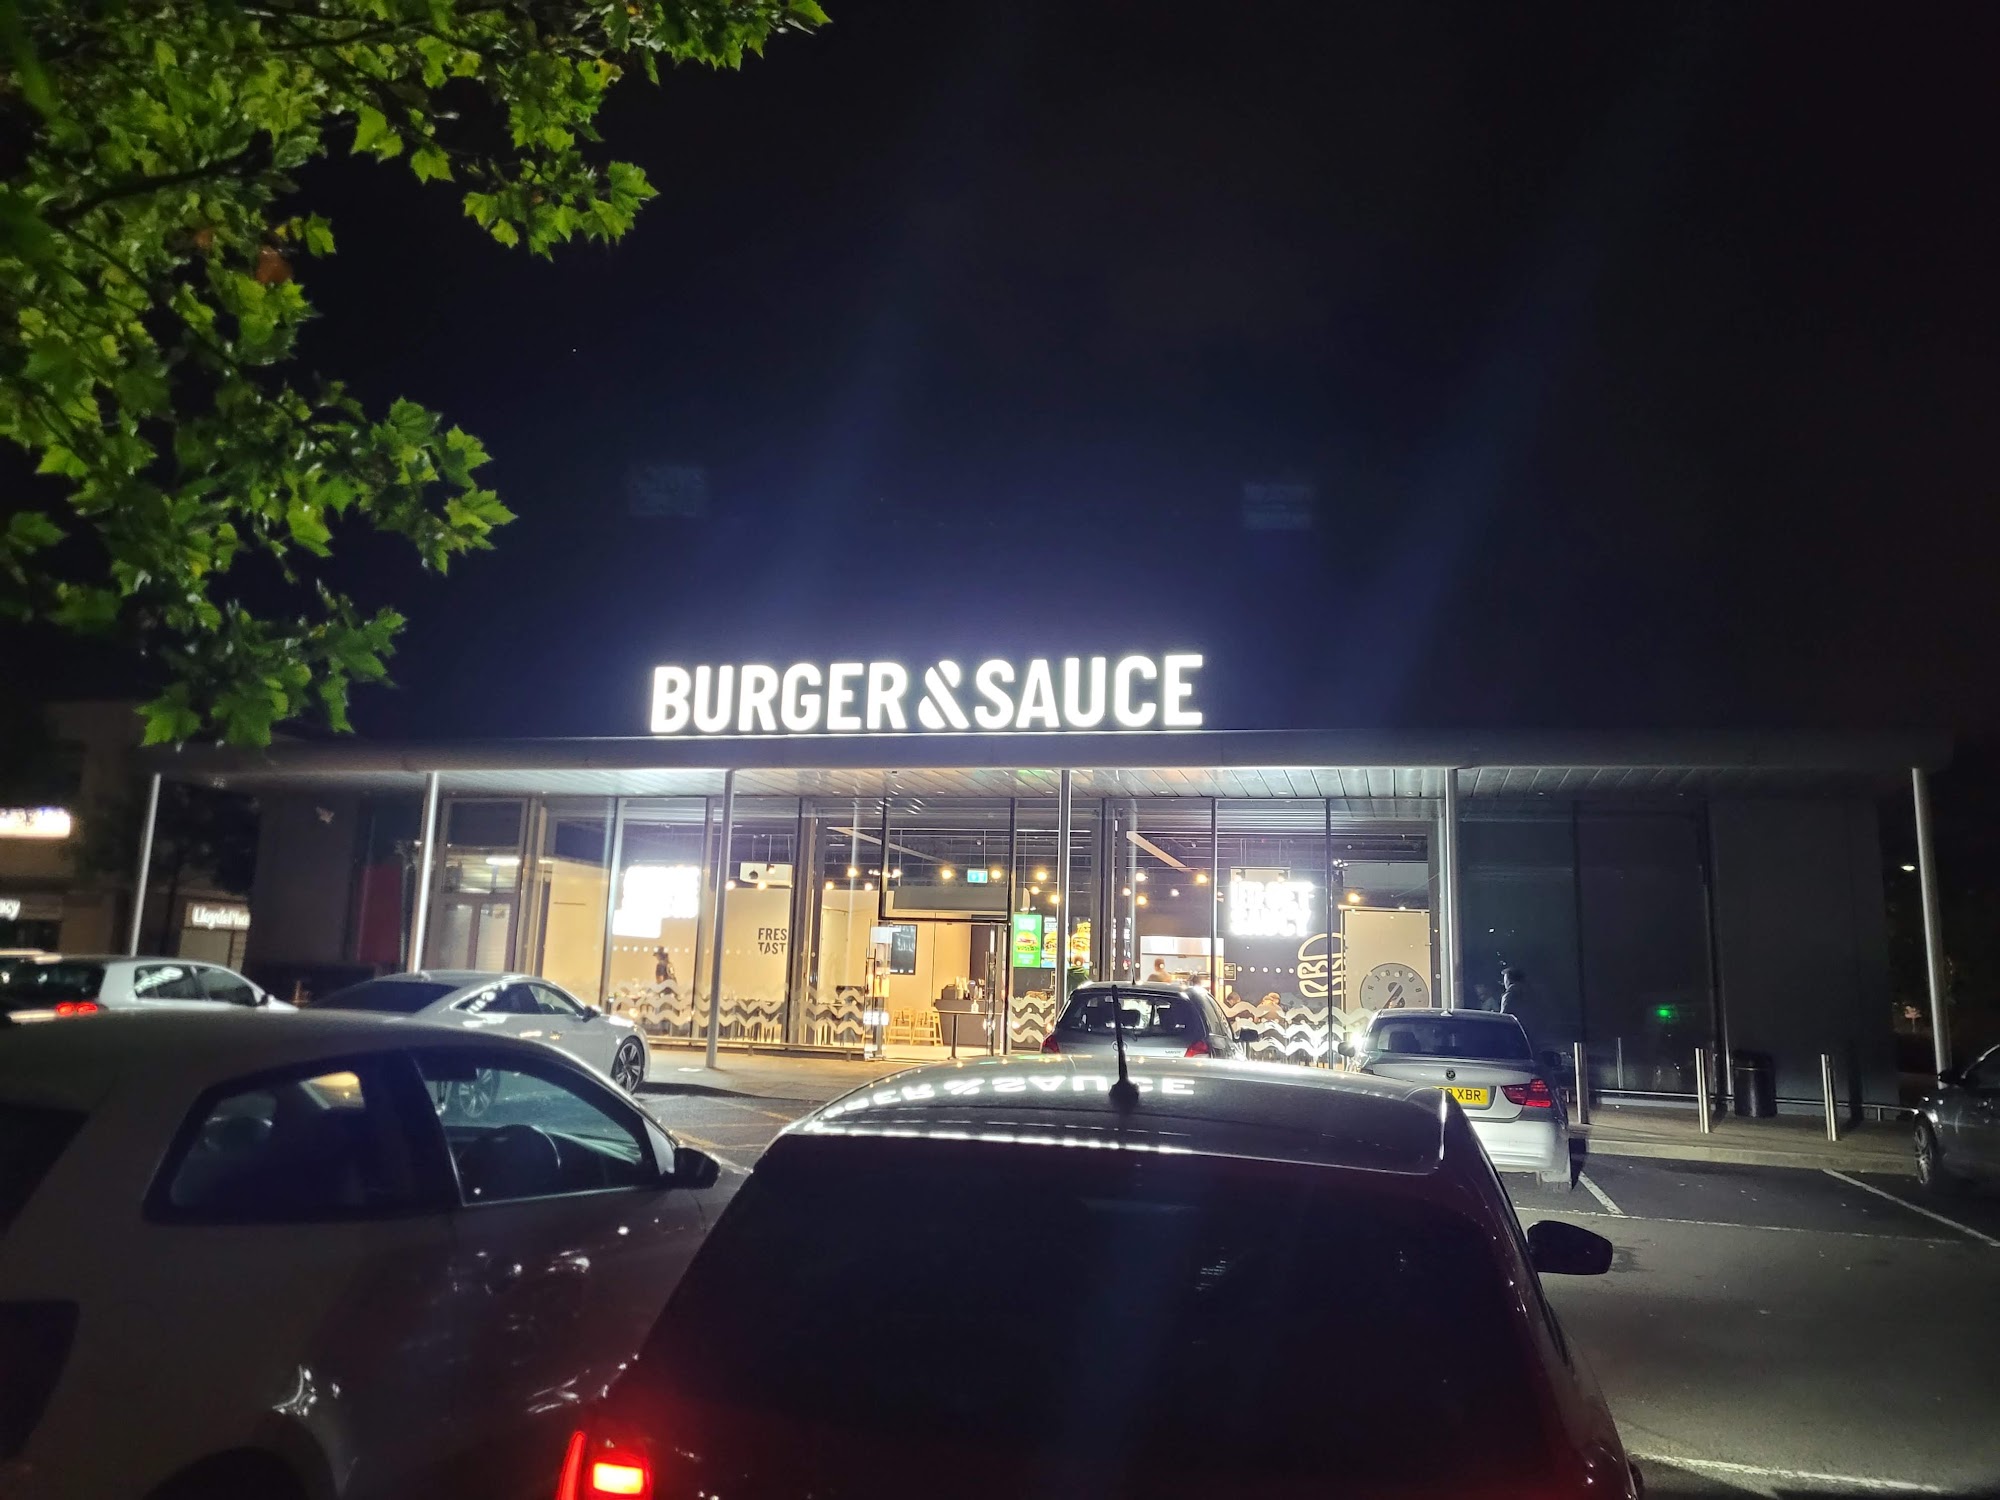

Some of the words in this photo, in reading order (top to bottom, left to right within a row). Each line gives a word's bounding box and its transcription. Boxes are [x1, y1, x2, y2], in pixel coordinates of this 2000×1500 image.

[651, 661, 908, 733] BURGER
[758, 927, 788, 941] FRES
[757, 941, 787, 955] TAST
[1457, 1088, 1482, 1101] XBR
